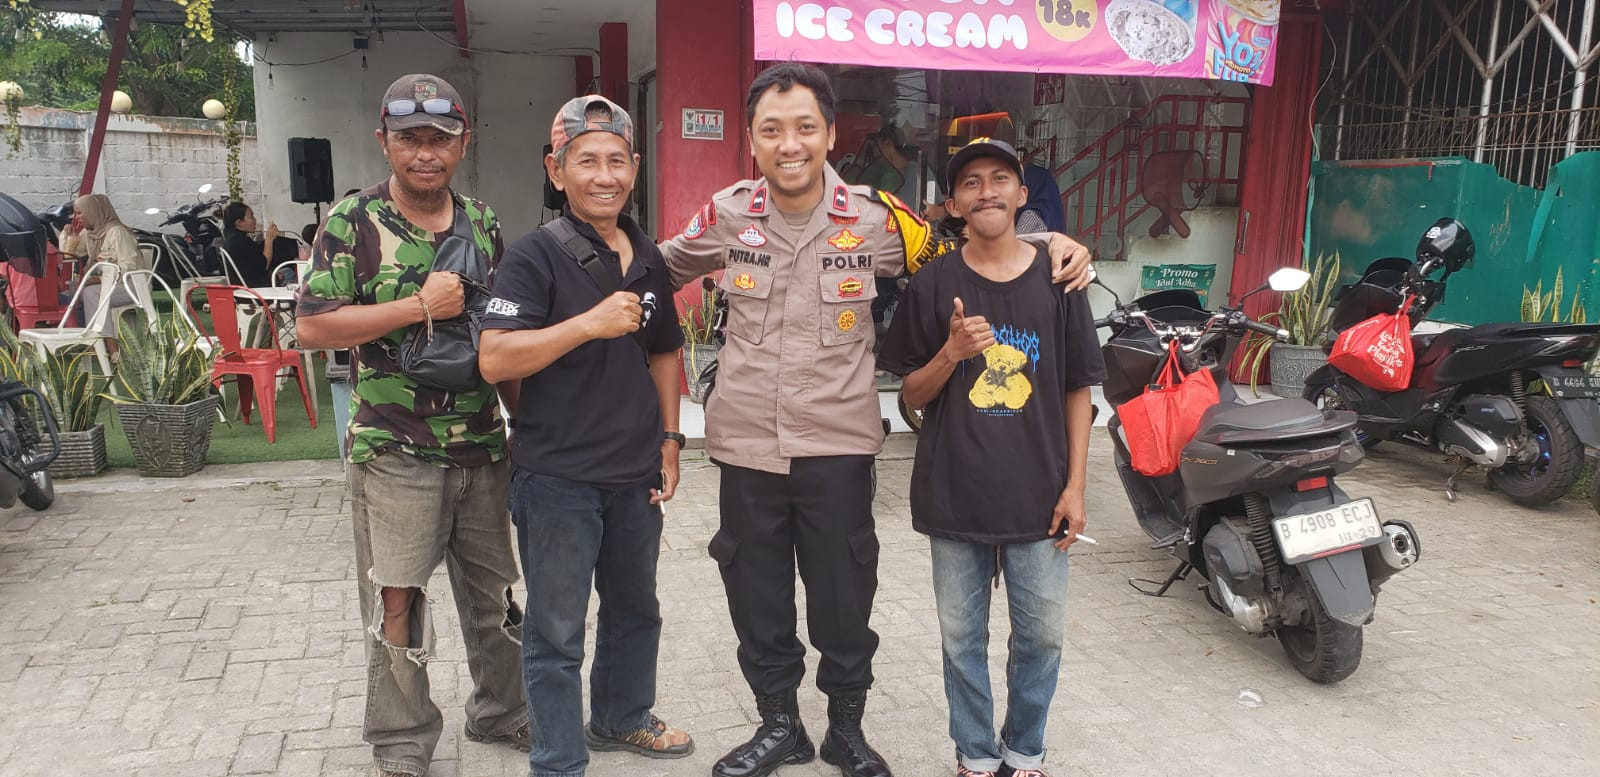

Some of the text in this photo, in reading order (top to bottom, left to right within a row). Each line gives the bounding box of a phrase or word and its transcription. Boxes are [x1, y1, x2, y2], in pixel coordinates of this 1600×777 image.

[776, 2, 1028, 49] ICE CREAM
[822, 254, 872, 271] POLRI
[1160, 268, 1199, 279] Promo
[1176, 277, 1197, 288] Adha
[1280, 503, 1372, 540] B 4908 ECJ
